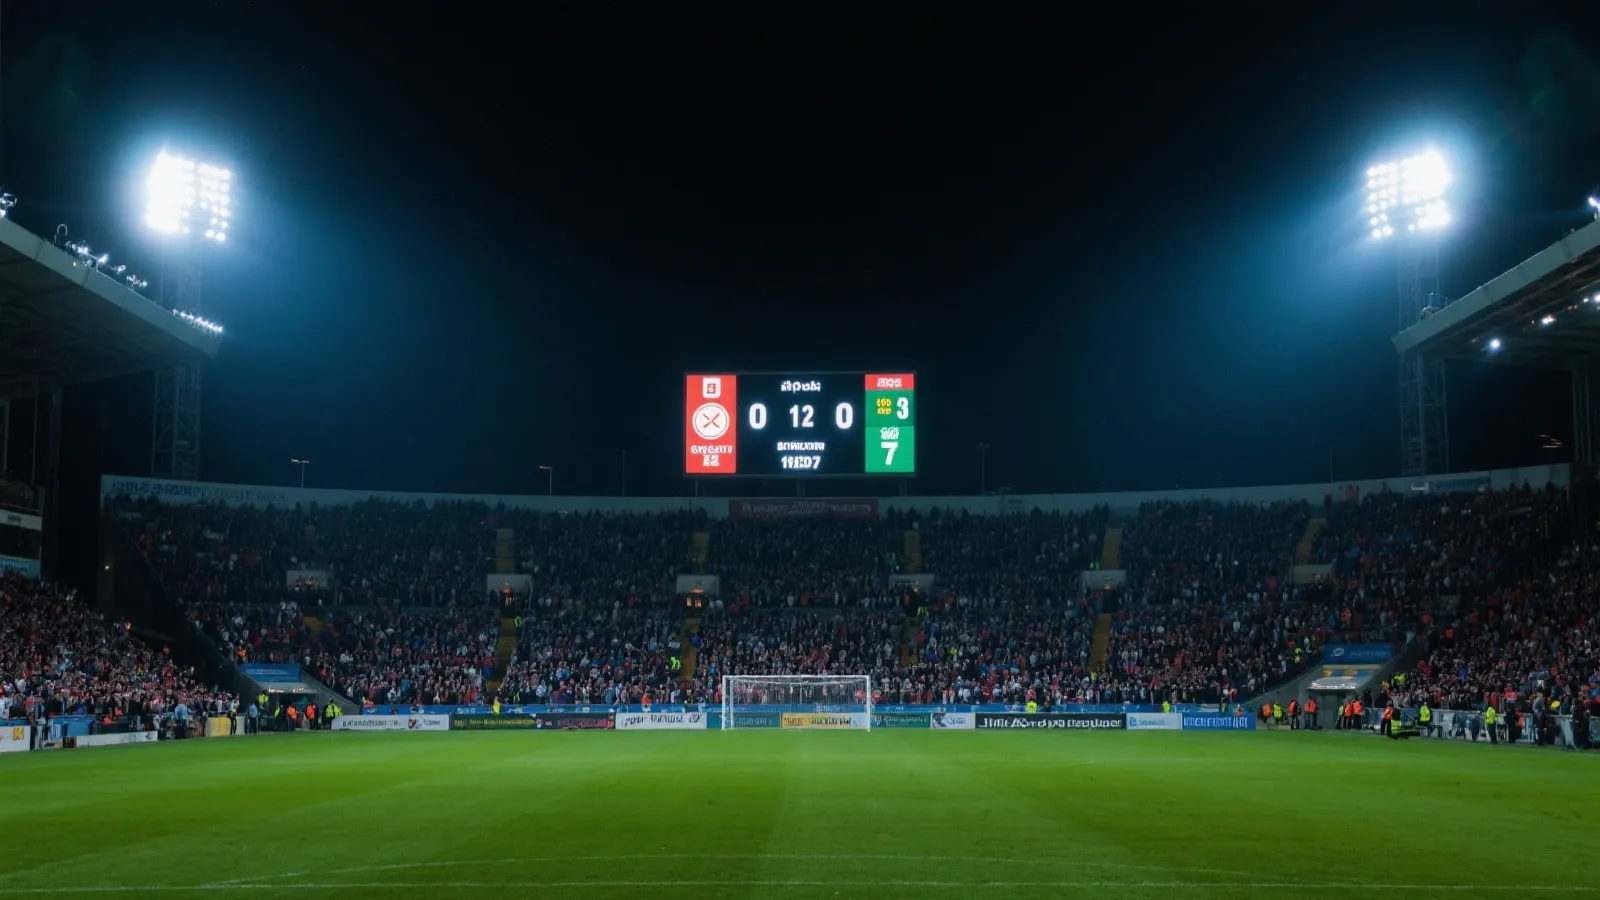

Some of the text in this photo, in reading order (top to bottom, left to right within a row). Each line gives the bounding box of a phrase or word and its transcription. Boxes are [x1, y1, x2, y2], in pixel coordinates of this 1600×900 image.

[749, 403, 767, 430] 0
[789, 404, 815, 428] 12
[836, 402, 853, 429] 0
[896, 397, 909, 420] 3
[880, 441, 899, 466] 7
